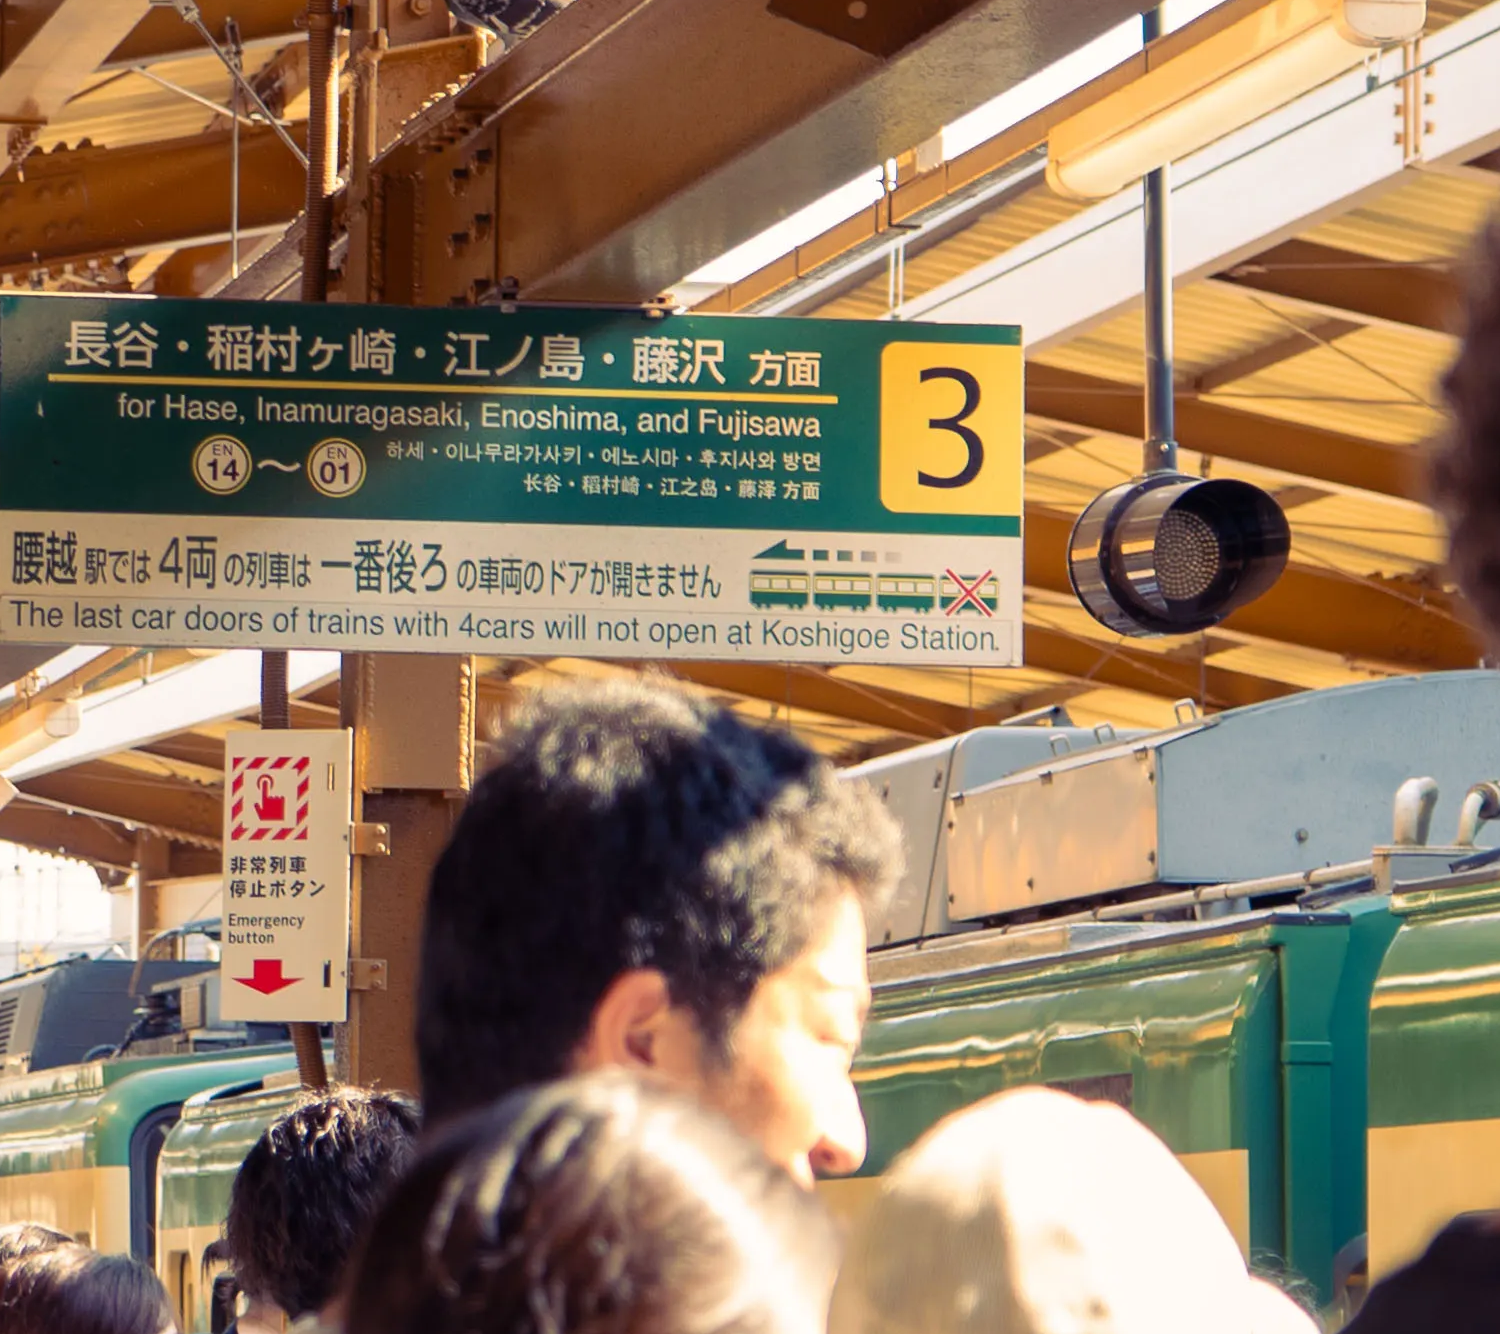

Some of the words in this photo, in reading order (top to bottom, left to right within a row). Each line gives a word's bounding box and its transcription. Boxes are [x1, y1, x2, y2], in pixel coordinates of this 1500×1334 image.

[750, 350, 822, 388] 方面
[117, 394, 156, 419] for
[164, 395, 247, 425] Hase,
[257, 396, 471, 433] Inamuragasaki,
[481, 402, 628, 436] Enoshima,
[636, 408, 689, 434] and
[699, 408, 821, 441] Fujisawa
[918, 367, 984, 489] 3
[212, 444, 234, 457] EN
[327, 447, 349, 460] EN
[782, 452, 821, 473] 방면
[206, 459, 240, 482] 14
[319, 462, 350, 485] 01
[10, 601, 64, 629] The
[73, 603, 124, 630] last
[132, 608, 176, 631] car
[184, 606, 264, 634] doors
[272, 608, 300, 634] of
[307, 610, 385, 637] trains
[393, 612, 450, 638] with
[458, 615, 536, 640] 4cars
[544, 615, 588, 642] will
[597, 617, 640, 643] not
[648, 623, 718, 650] open
[727, 622, 753, 647] at
[762, 621, 891, 655] Koshigoe
[899, 624, 1000, 652] Station.
[229, 856, 307, 875] 非常列車
[229, 880, 325, 898] 停止ボタン
[228, 914, 305, 929] Emergency
[228, 932, 275, 944] button
